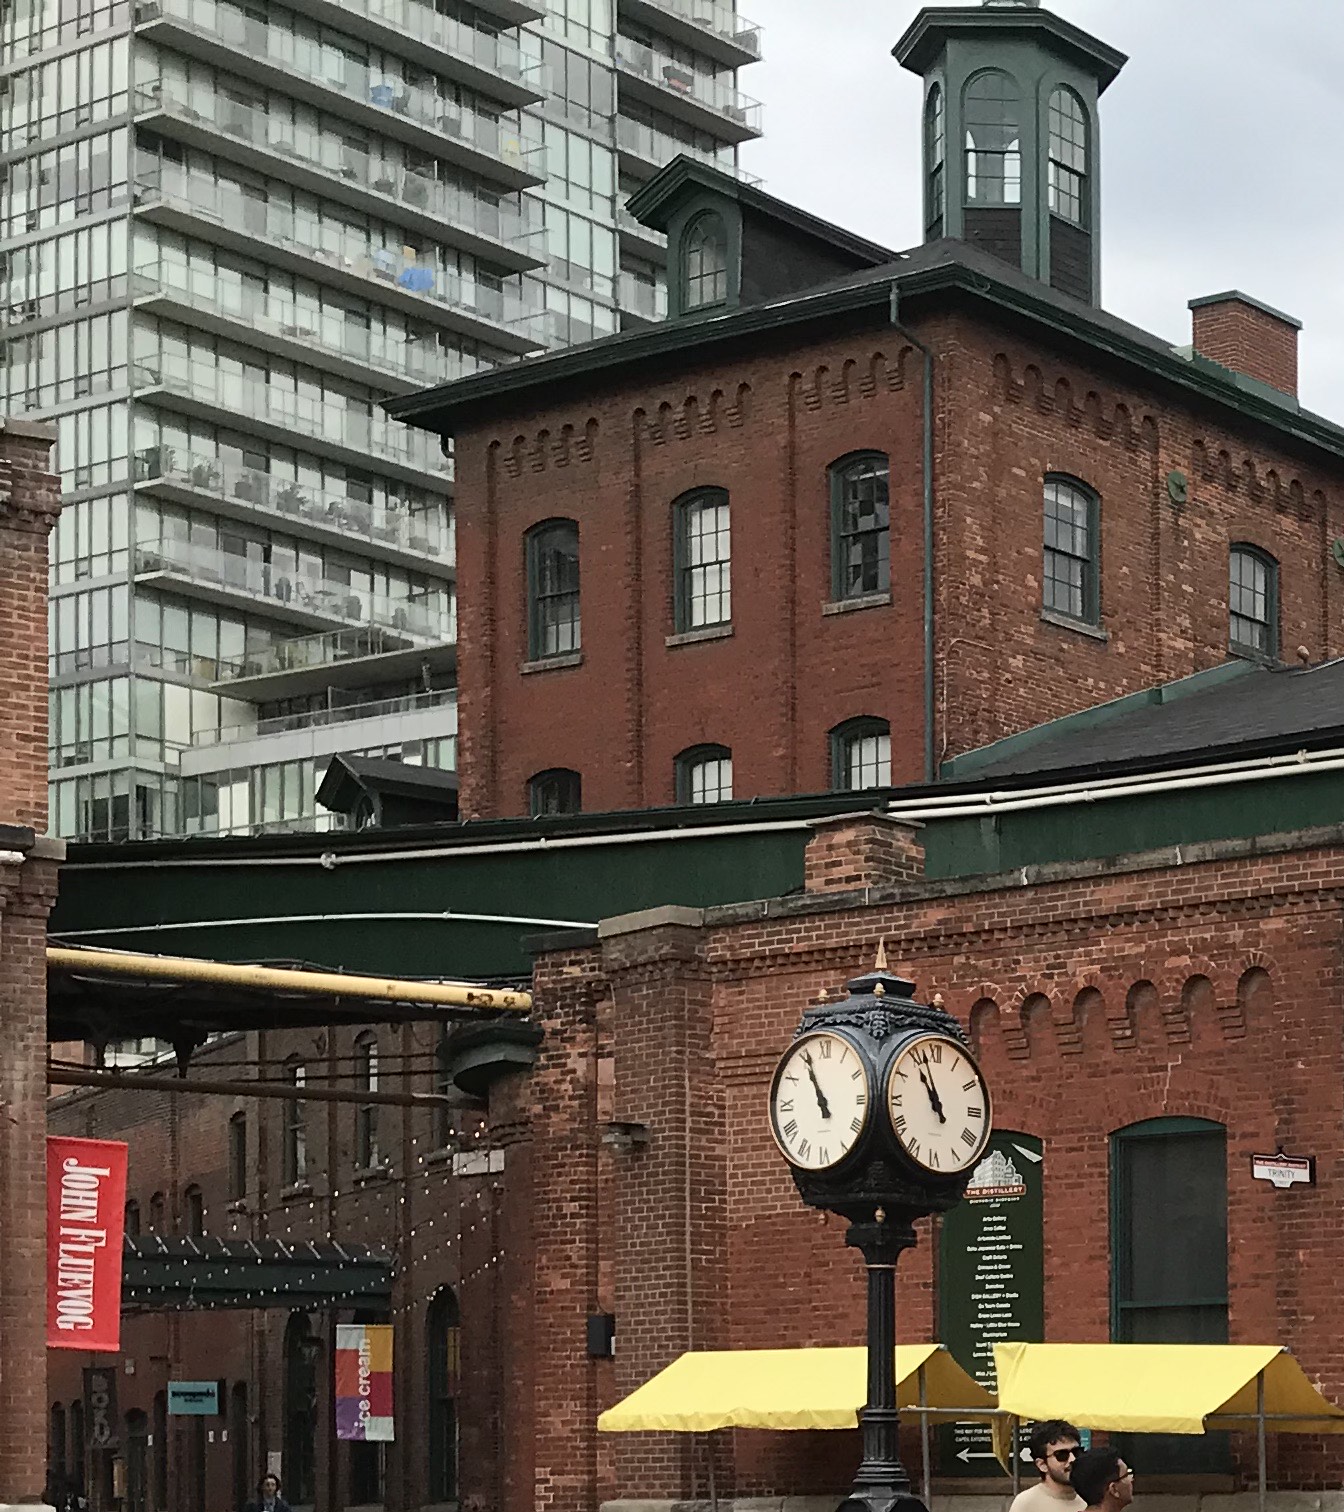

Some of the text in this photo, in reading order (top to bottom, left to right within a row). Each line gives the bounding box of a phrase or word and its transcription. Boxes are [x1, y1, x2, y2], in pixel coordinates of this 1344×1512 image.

[982, 1187, 1023, 1195] DISTILLERY
[1267, 1168, 1295, 1178] TRINITY
[56, 1157, 110, 1331] JOHN FLUEVOG
[353, 1338, 371, 1428] ice cream
